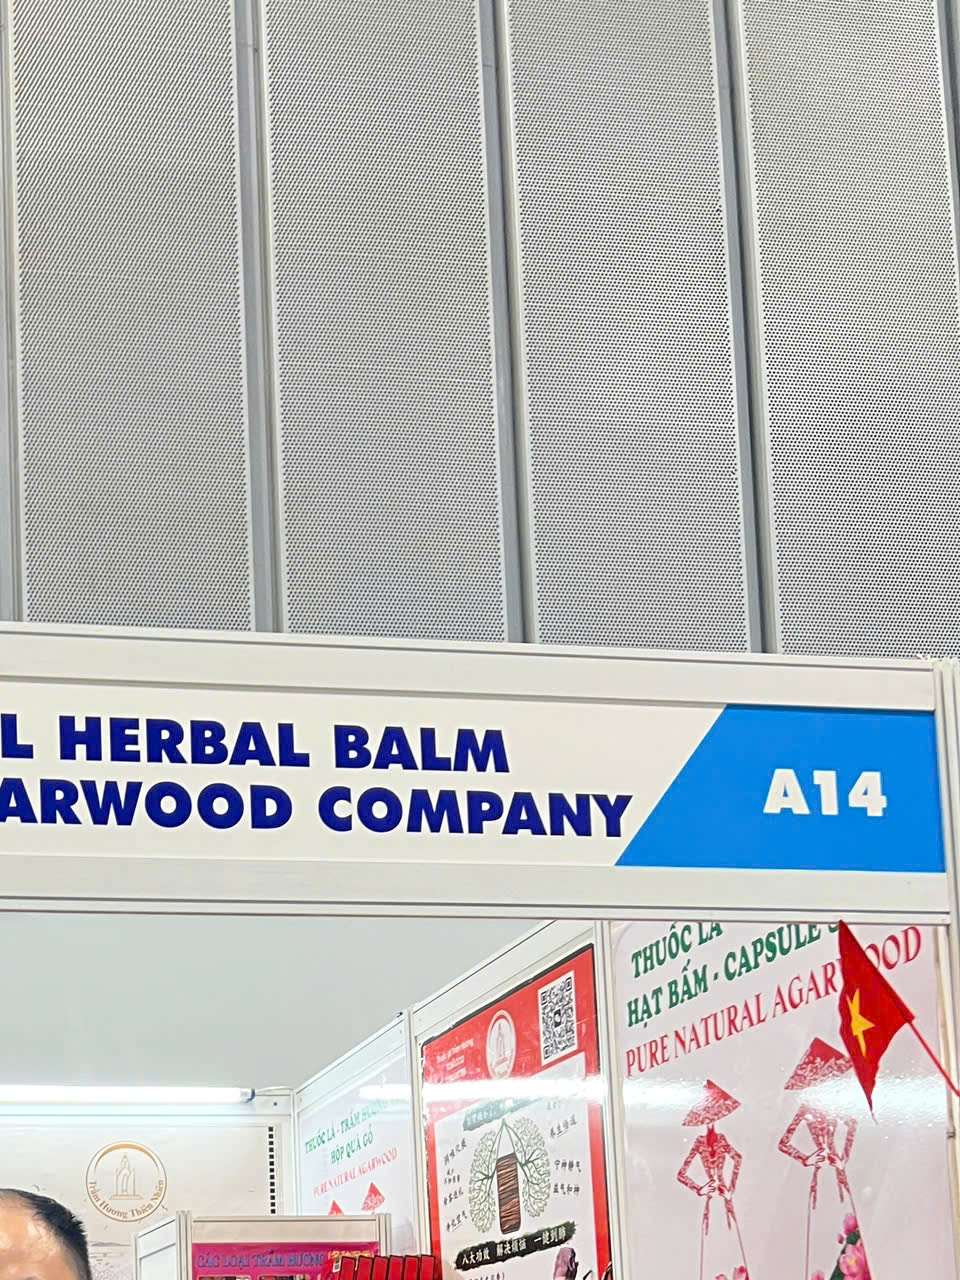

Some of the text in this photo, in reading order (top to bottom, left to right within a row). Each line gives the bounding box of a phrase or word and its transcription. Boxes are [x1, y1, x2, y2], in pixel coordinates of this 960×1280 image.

[59, 717, 311, 769] HERBAL
[334, 724, 510, 774] BALM
[318, 785, 634, 840] COMPANY
[762, 768, 888, 818] A14
[627, 923, 822, 1029] HẠT BẤM CAPSULE
[631, 922, 692, 979] THUỐC
[626, 993, 768, 1078] PURE NATURAL
[358, 1147, 398, 1176] AGARWOOD
